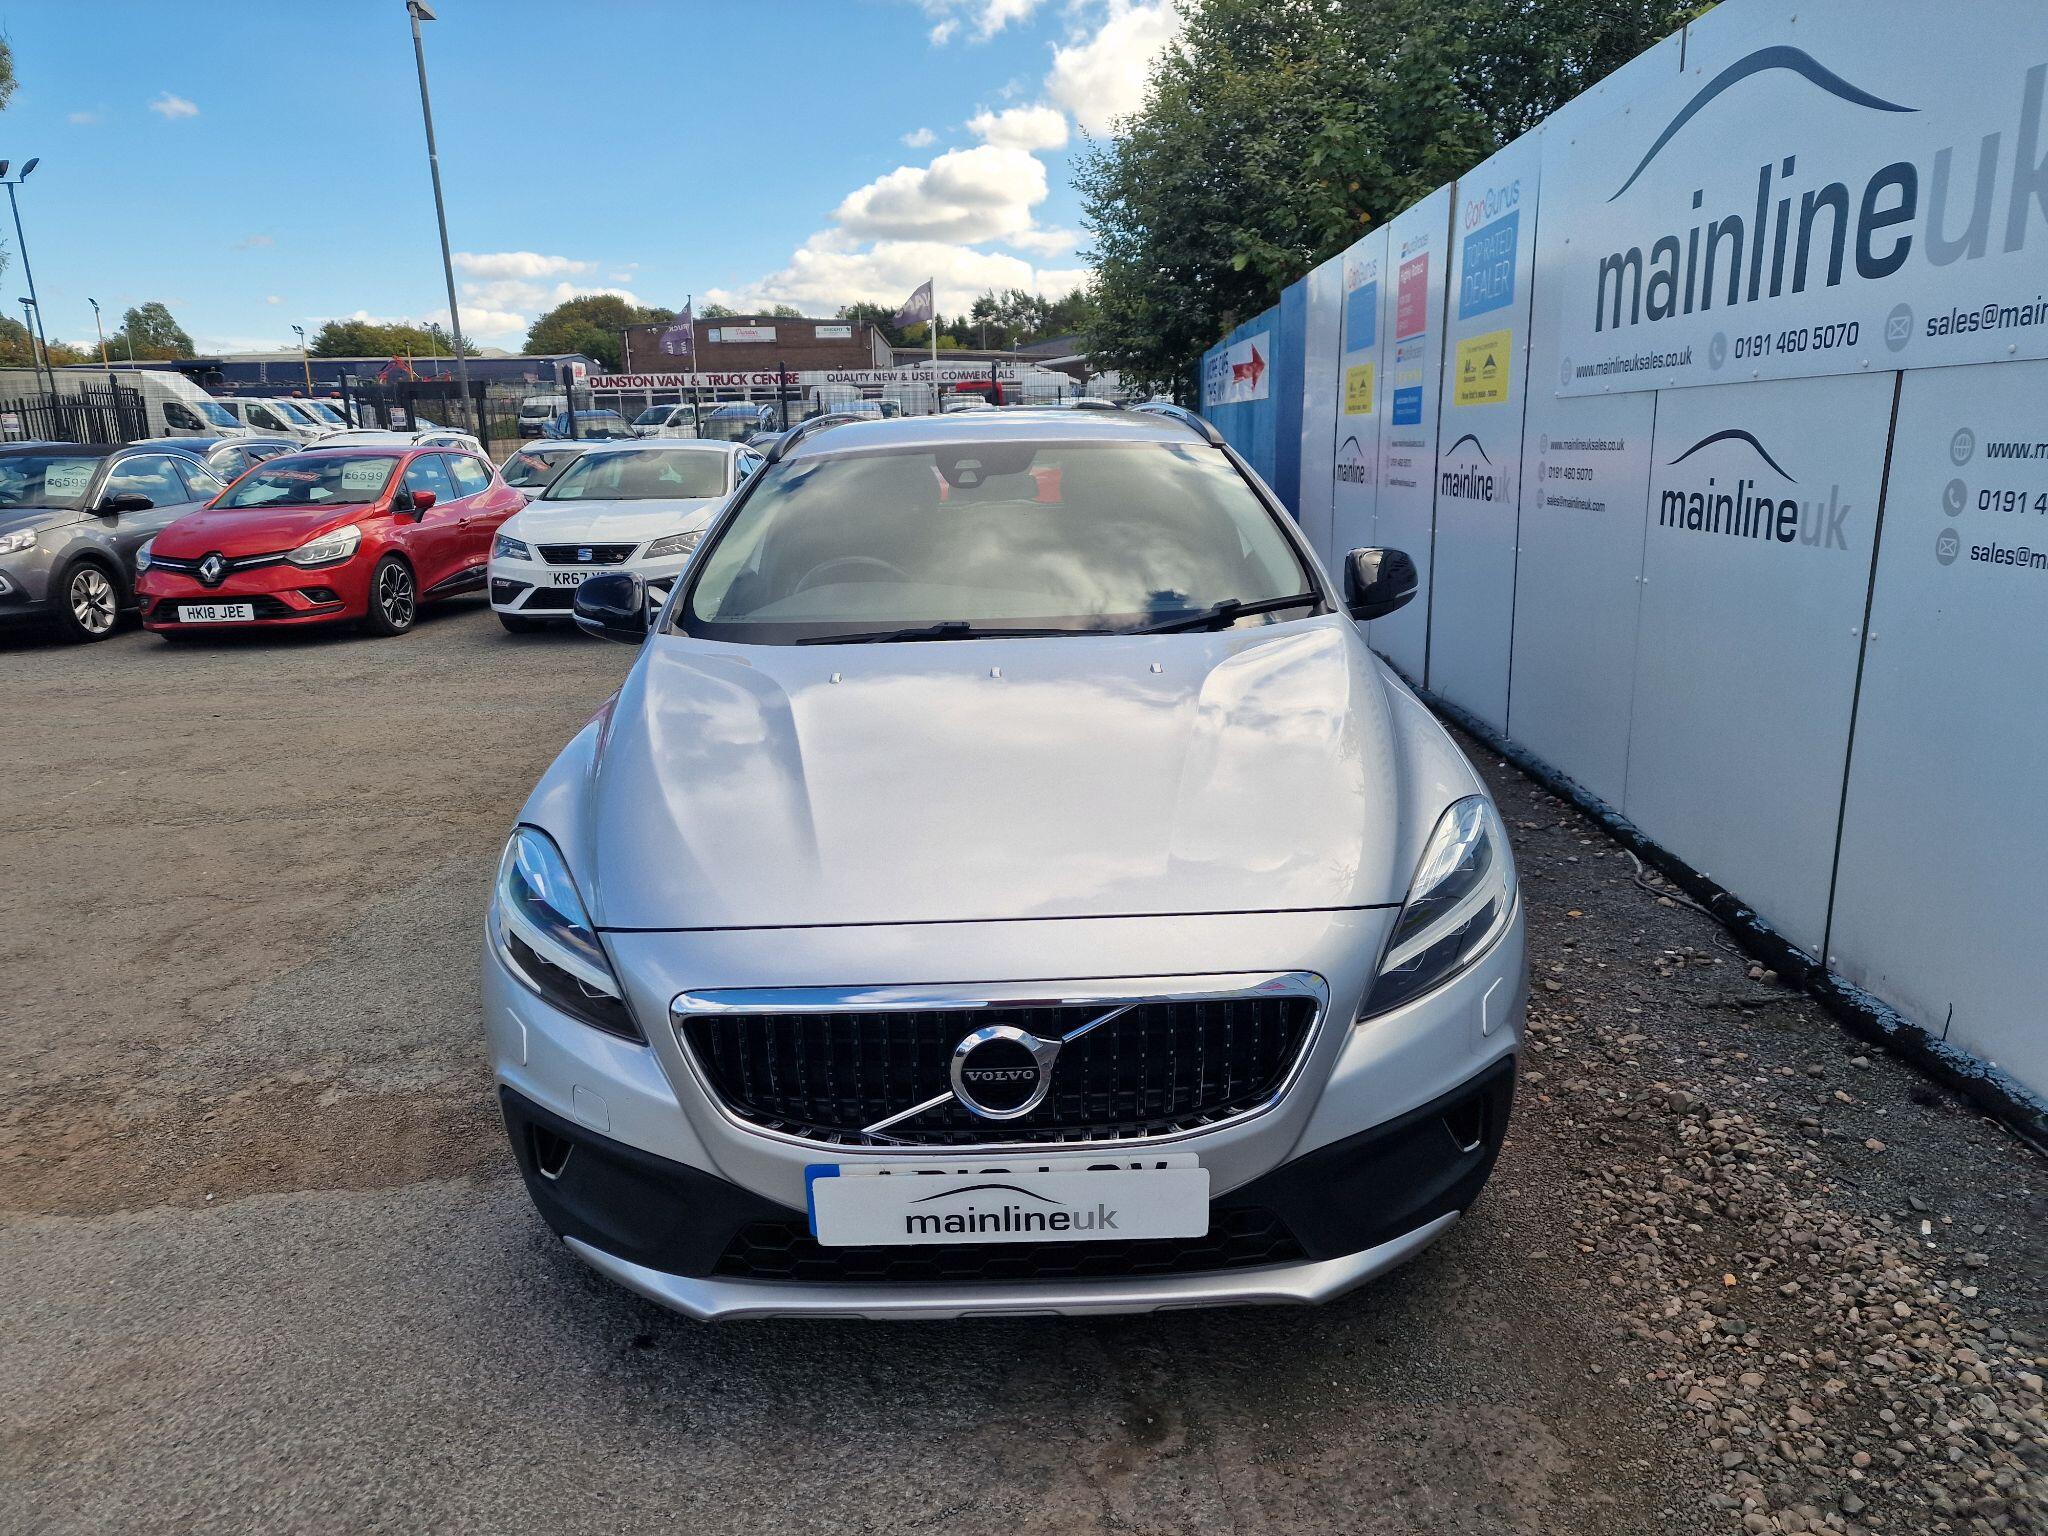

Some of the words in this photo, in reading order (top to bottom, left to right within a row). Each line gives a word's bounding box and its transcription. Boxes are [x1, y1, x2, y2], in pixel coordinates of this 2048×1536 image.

[1465, 260, 1510, 307] DEALER
[1735, 334, 1771, 358] 0191
[1776, 329, 1808, 353] 460
[1812, 321, 1859, 350] 5070
[827, 372, 870, 383] QUALITY
[874, 371, 898, 382] NEW
[901, 371, 908, 381] &
[942, 369, 1015, 380] COMMERCALS
[1576, 345, 1692, 379] www.mainlineuksales.co.uk
[590, 375, 654, 388] DUNSTON
[655, 375, 684, 387] VAN
[691, 375, 700, 386] &
[706, 374, 748, 386] TRUCK
[752, 372, 800, 385] CENRE
[1442, 464, 1512, 504] mainlineuk
[1660, 478, 1852, 552] mainlineuk
[1978, 489, 2027, 514] 0191
[187, 606, 216, 620] HK18
[966, 1070, 1035, 1081] VOLVO
[906, 1203, 1120, 1235] mainlineuk
